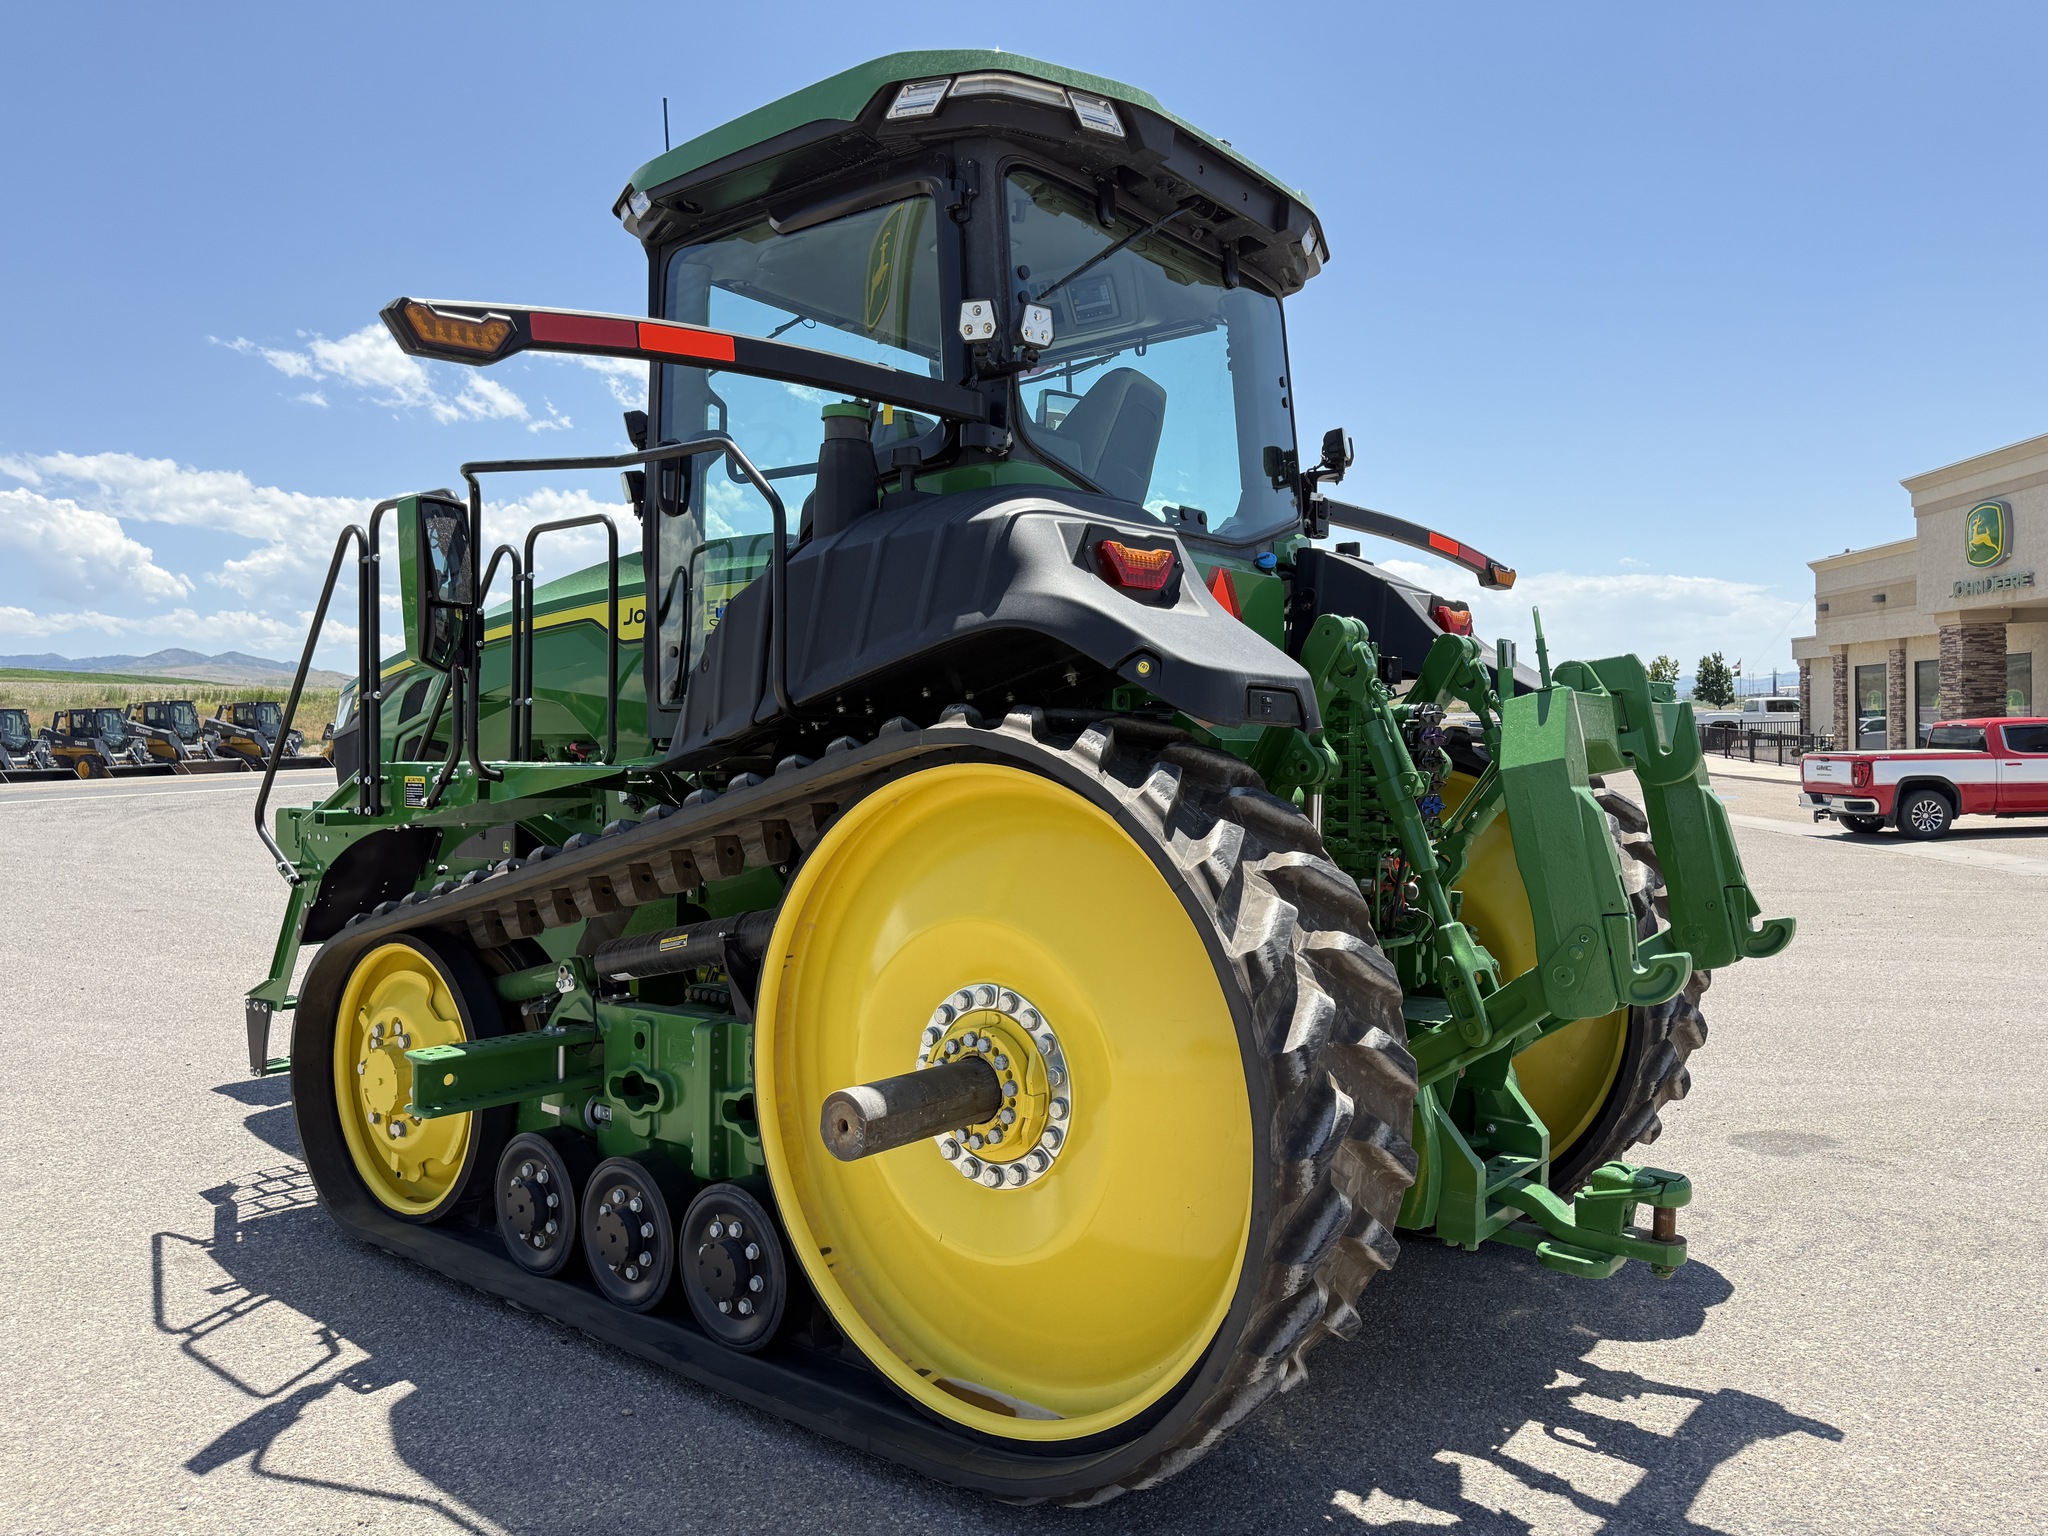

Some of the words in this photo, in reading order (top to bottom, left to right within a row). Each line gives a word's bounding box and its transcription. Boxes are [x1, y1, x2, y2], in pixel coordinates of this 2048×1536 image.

[1948, 580, 1984, 598] JOHN
[1984, 572, 2031, 593] DEERE
[136, 726, 152, 736] DEERE
